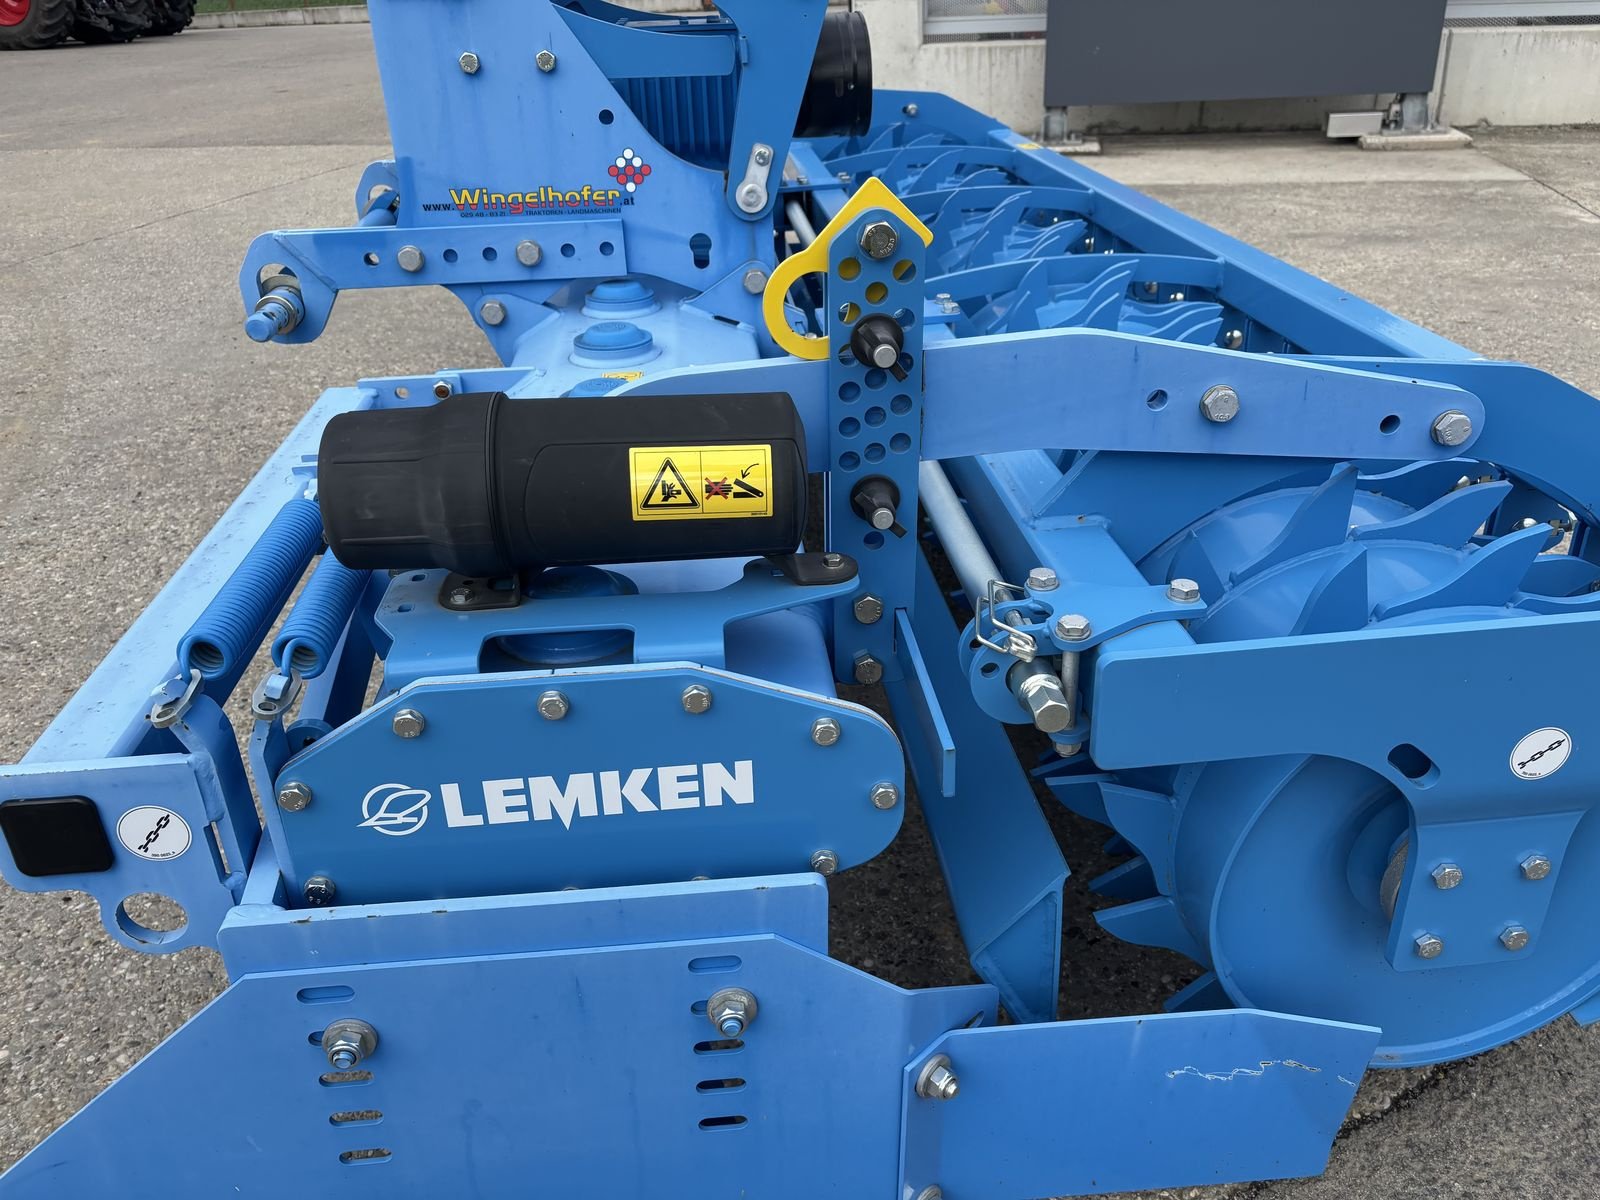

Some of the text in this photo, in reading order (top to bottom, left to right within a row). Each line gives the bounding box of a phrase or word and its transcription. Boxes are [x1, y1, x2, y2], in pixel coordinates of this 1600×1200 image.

[422, 186, 635, 214] www.Wingelhofer.at
[568, 207, 621, 215] LANDMASCHINEN
[440, 760, 754, 831] LEMKEN
